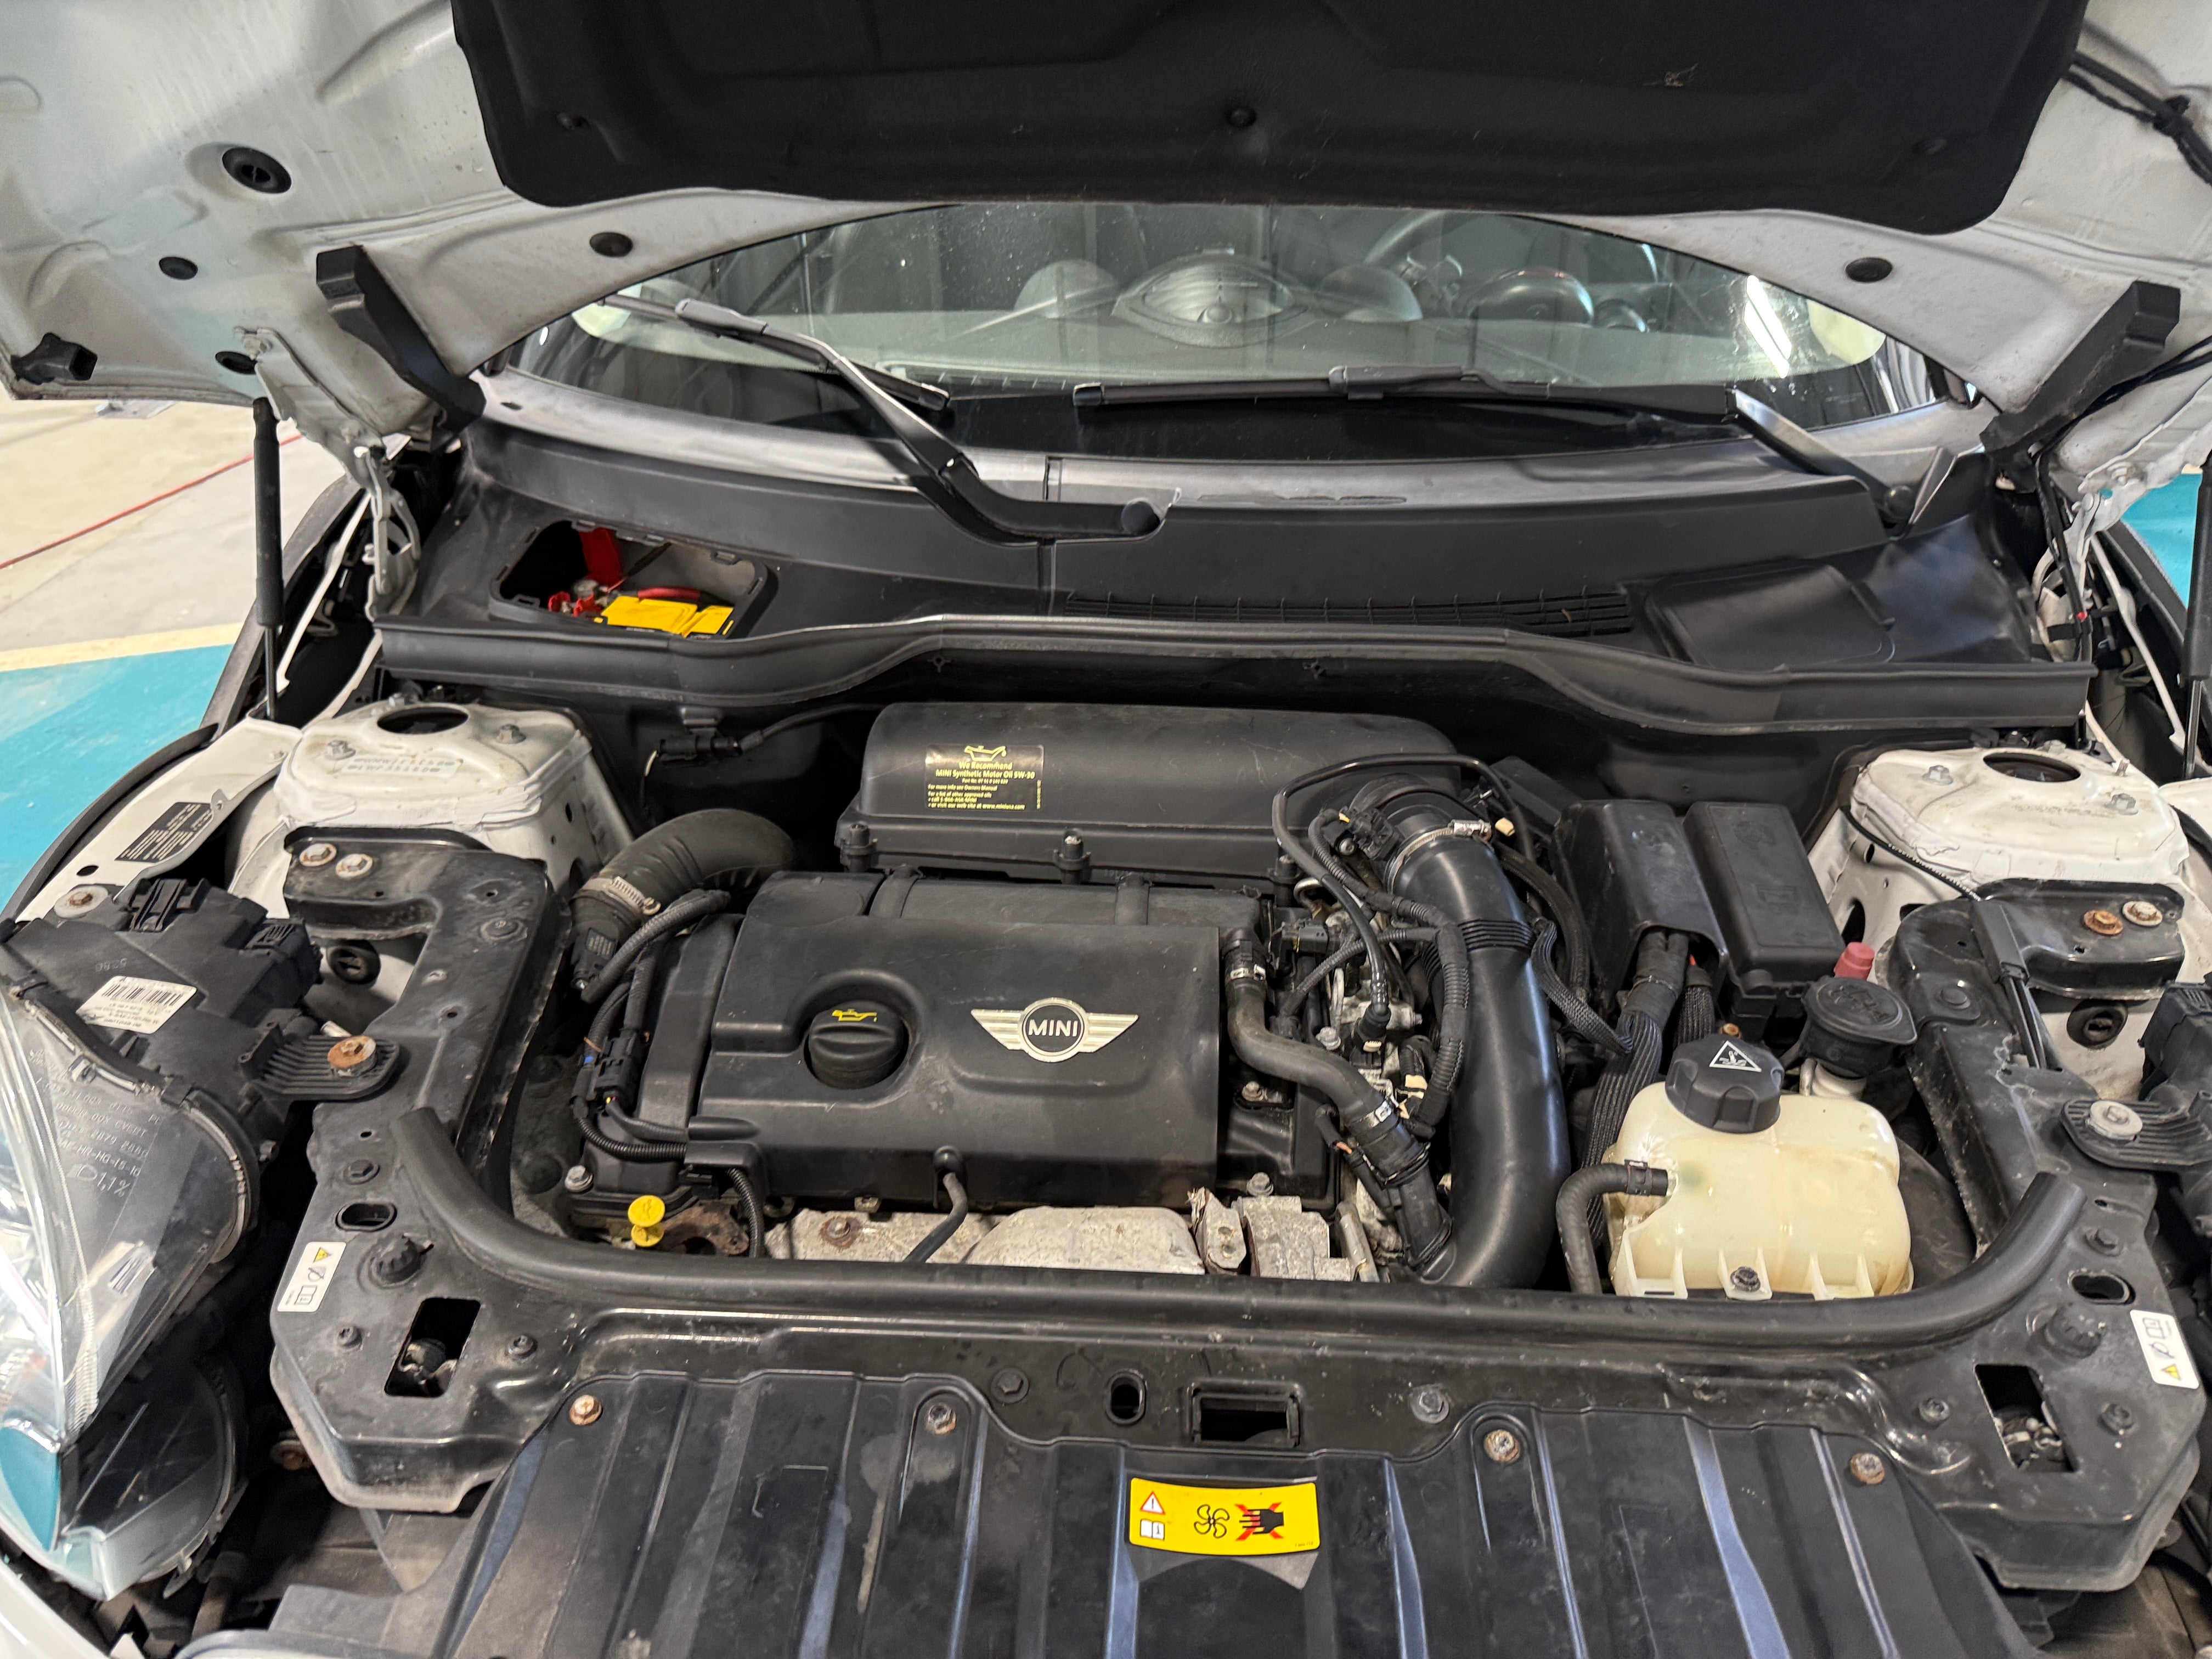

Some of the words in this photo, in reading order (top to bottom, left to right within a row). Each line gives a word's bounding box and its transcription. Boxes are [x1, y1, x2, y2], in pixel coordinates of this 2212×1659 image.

[959, 761, 970, 769] We
[971, 761, 1013, 770] Recommend
[935, 769, 952, 777] MINI
[952, 769, 982, 779] Synthetic
[983, 770, 1002, 778] Motor
[1003, 770, 1013, 778] Oil
[1014, 771, 1036, 779] 5W-30
[1028, 1019, 1079, 1037] MINI
